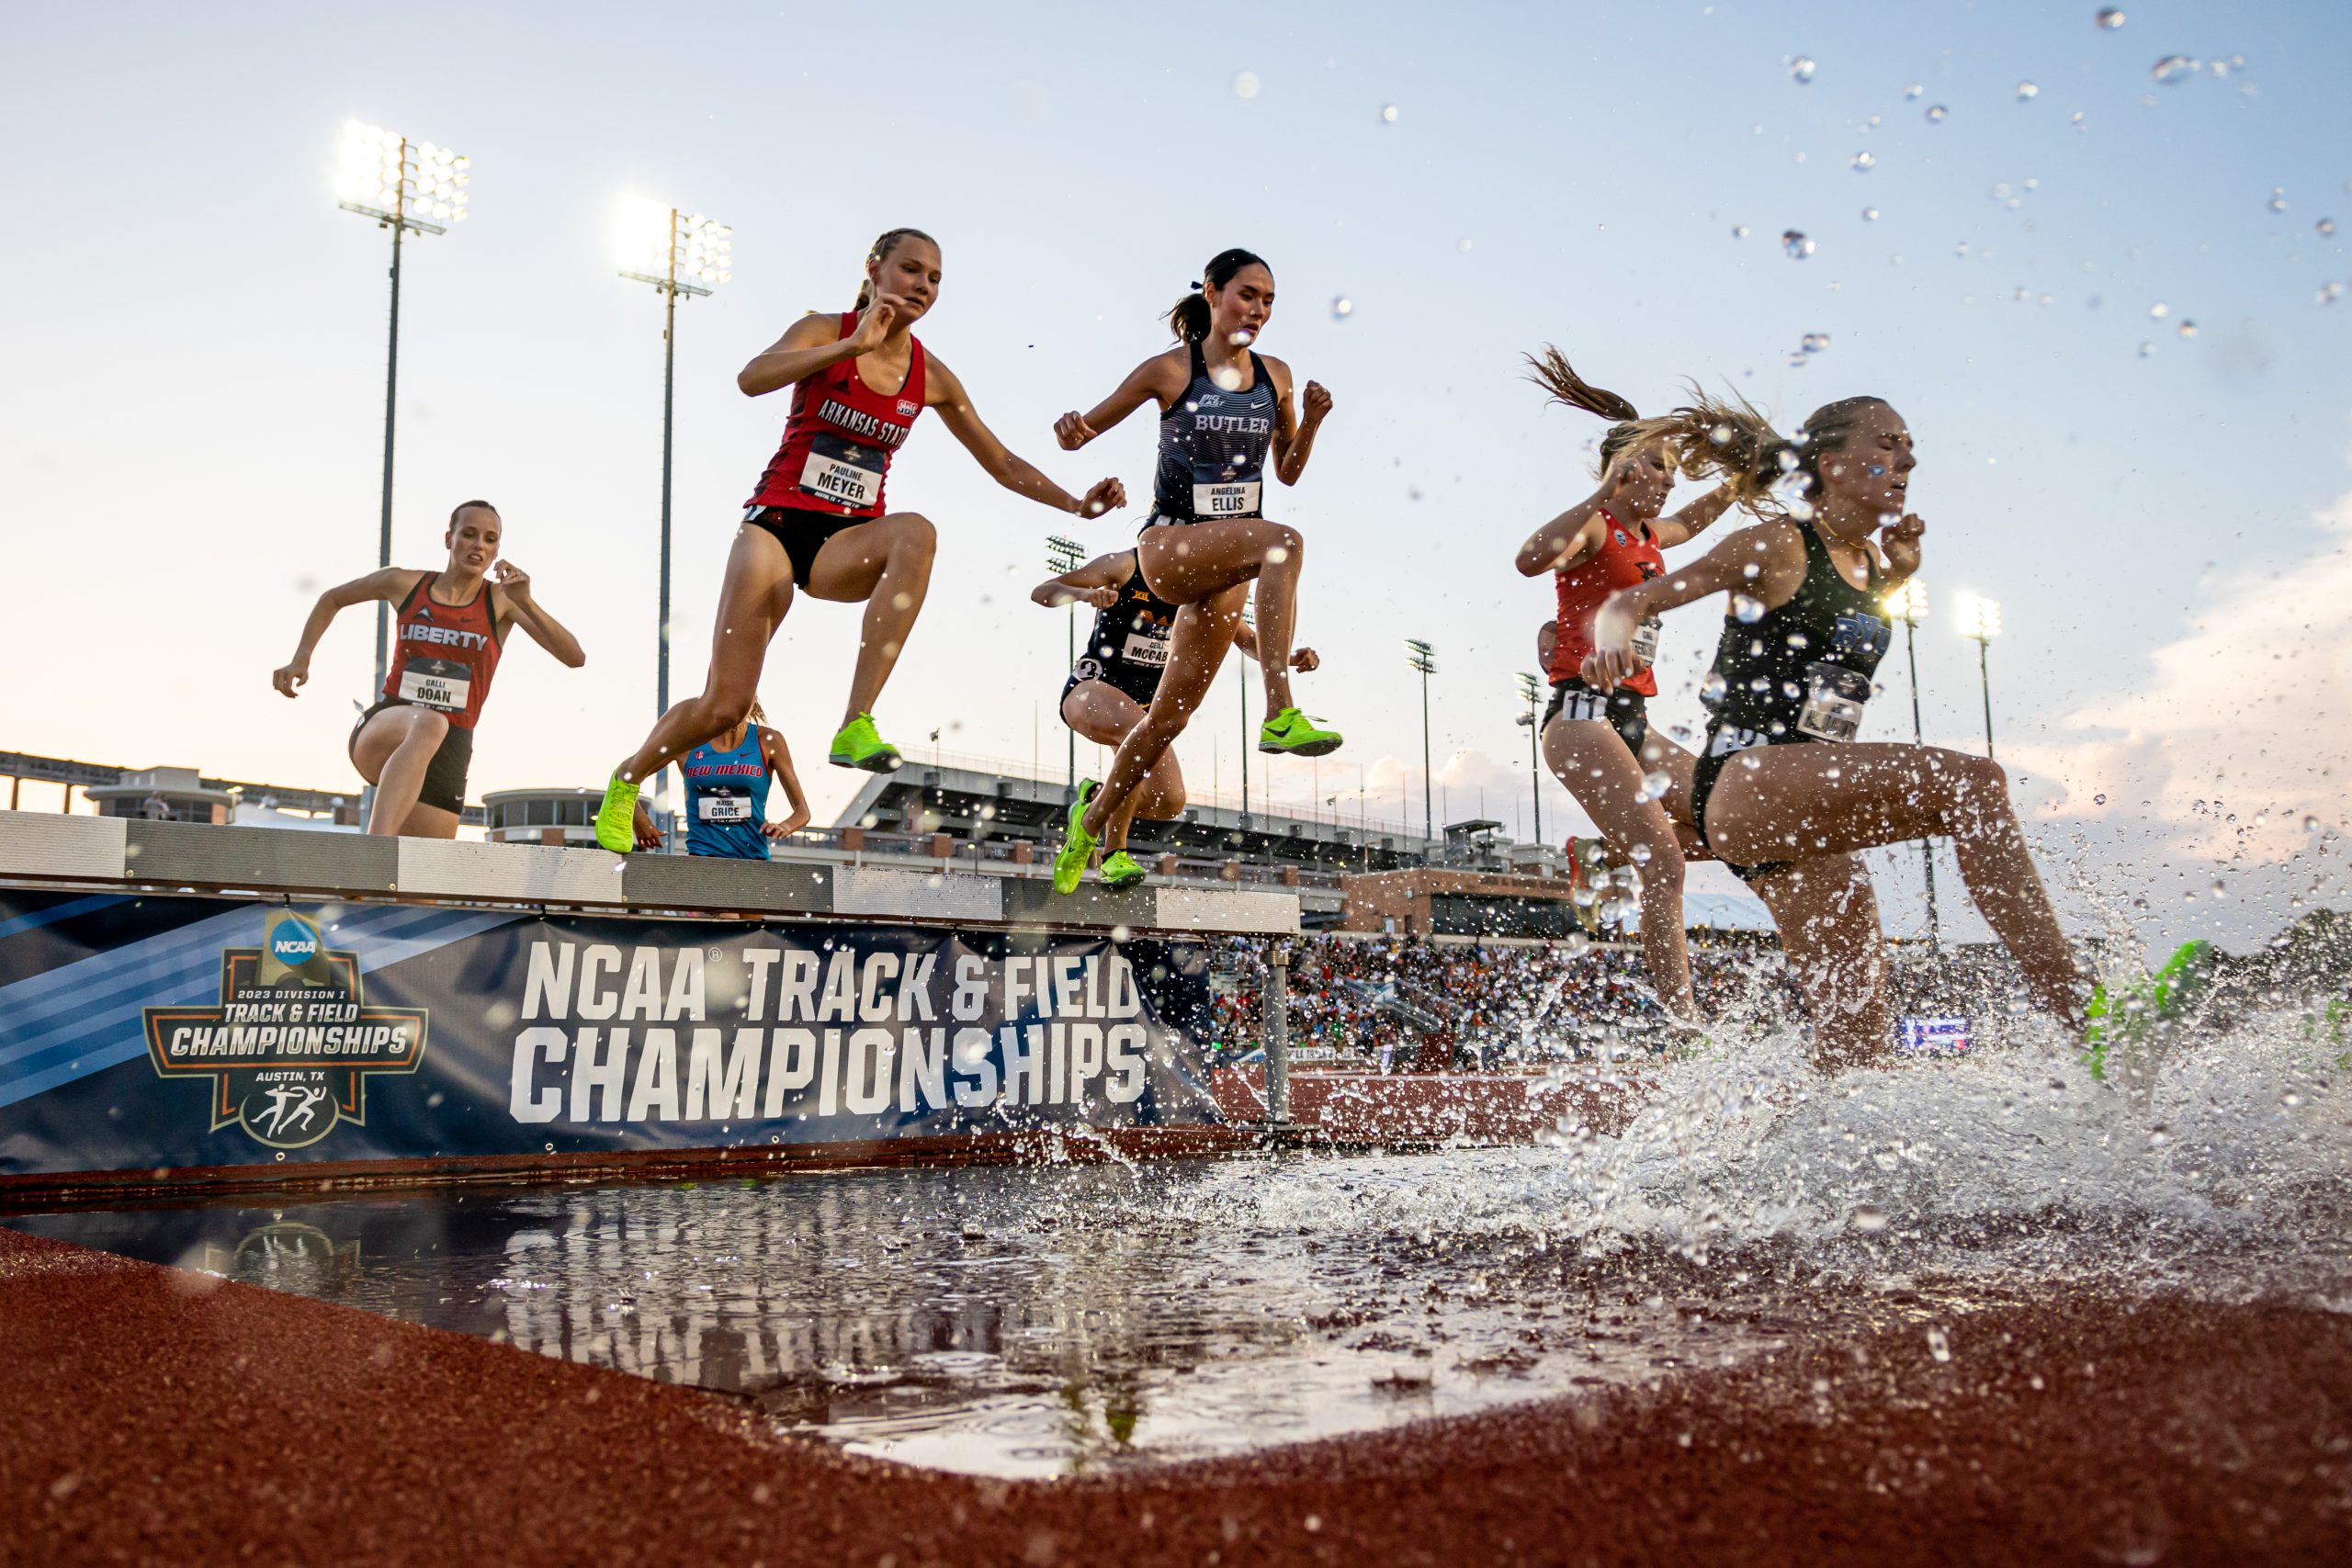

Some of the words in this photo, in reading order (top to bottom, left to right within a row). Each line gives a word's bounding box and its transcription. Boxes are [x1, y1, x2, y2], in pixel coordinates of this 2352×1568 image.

[818, 399, 879, 437] ARKANSAS
[1194, 414, 1269, 434] BUTLER
[830, 463, 863, 481] PAULINE
[817, 472, 865, 500] MEYER
[1211, 487, 1245, 495] ANGELINA
[1212, 497, 1245, 511] ELLIS
[400, 624, 488, 651] LIBERTY
[1131, 647, 1169, 661] MCCAB
[417, 687, 451, 703] DOAN
[1568, 692, 1597, 720] 11
[686, 765, 713, 778] NEW
[715, 764, 763, 778] MEXICO
[712, 807, 740, 817] GRICE
[275, 941, 316, 953] NCAA
[742, 948, 937, 1021] TRACK
[952, 954, 989, 1021] &
[1005, 955, 1141, 1021] FIELD
[238, 990, 270, 998] 2023
[276, 990, 335, 998] DIVISION
[339, 990, 345, 998] I
[224, 1003, 286, 1022] TRACK
[288, 1004, 303, 1022] &
[307, 1003, 358, 1022] FIELD
[170, 1026, 408, 1056] CHAMPIONSHIPS
[255, 1071, 306, 1082] AUSTIN,
[310, 1071, 325, 1081] TX
[509, 1023, 1148, 1123] CHAMPIONSHIPS
